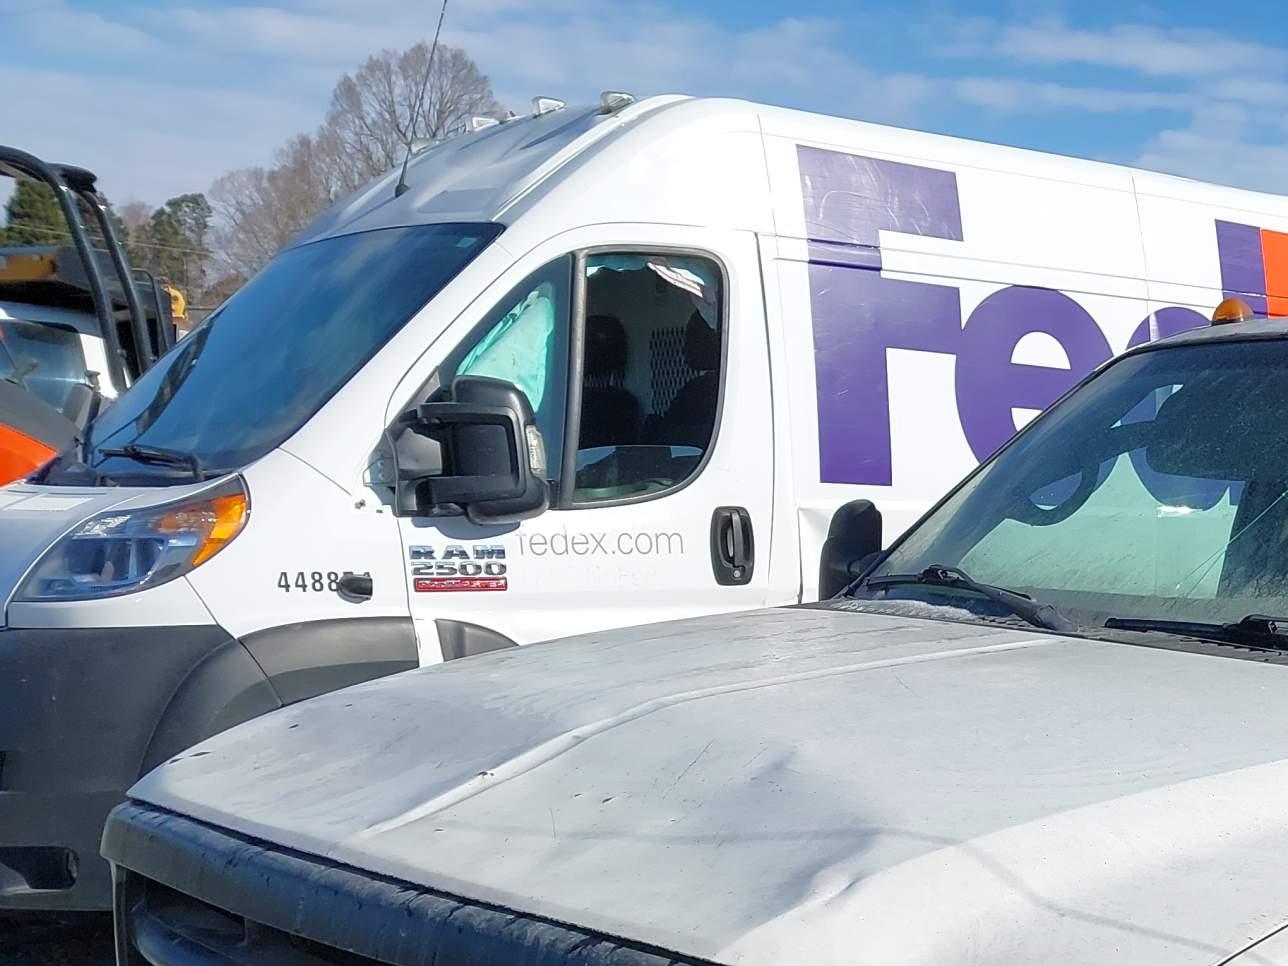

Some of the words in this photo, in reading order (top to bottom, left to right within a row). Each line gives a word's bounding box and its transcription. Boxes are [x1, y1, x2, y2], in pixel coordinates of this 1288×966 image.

[515, 523, 684, 556] fedex.com
[409, 544, 506, 560] RAM
[411, 561, 507, 576] 2500
